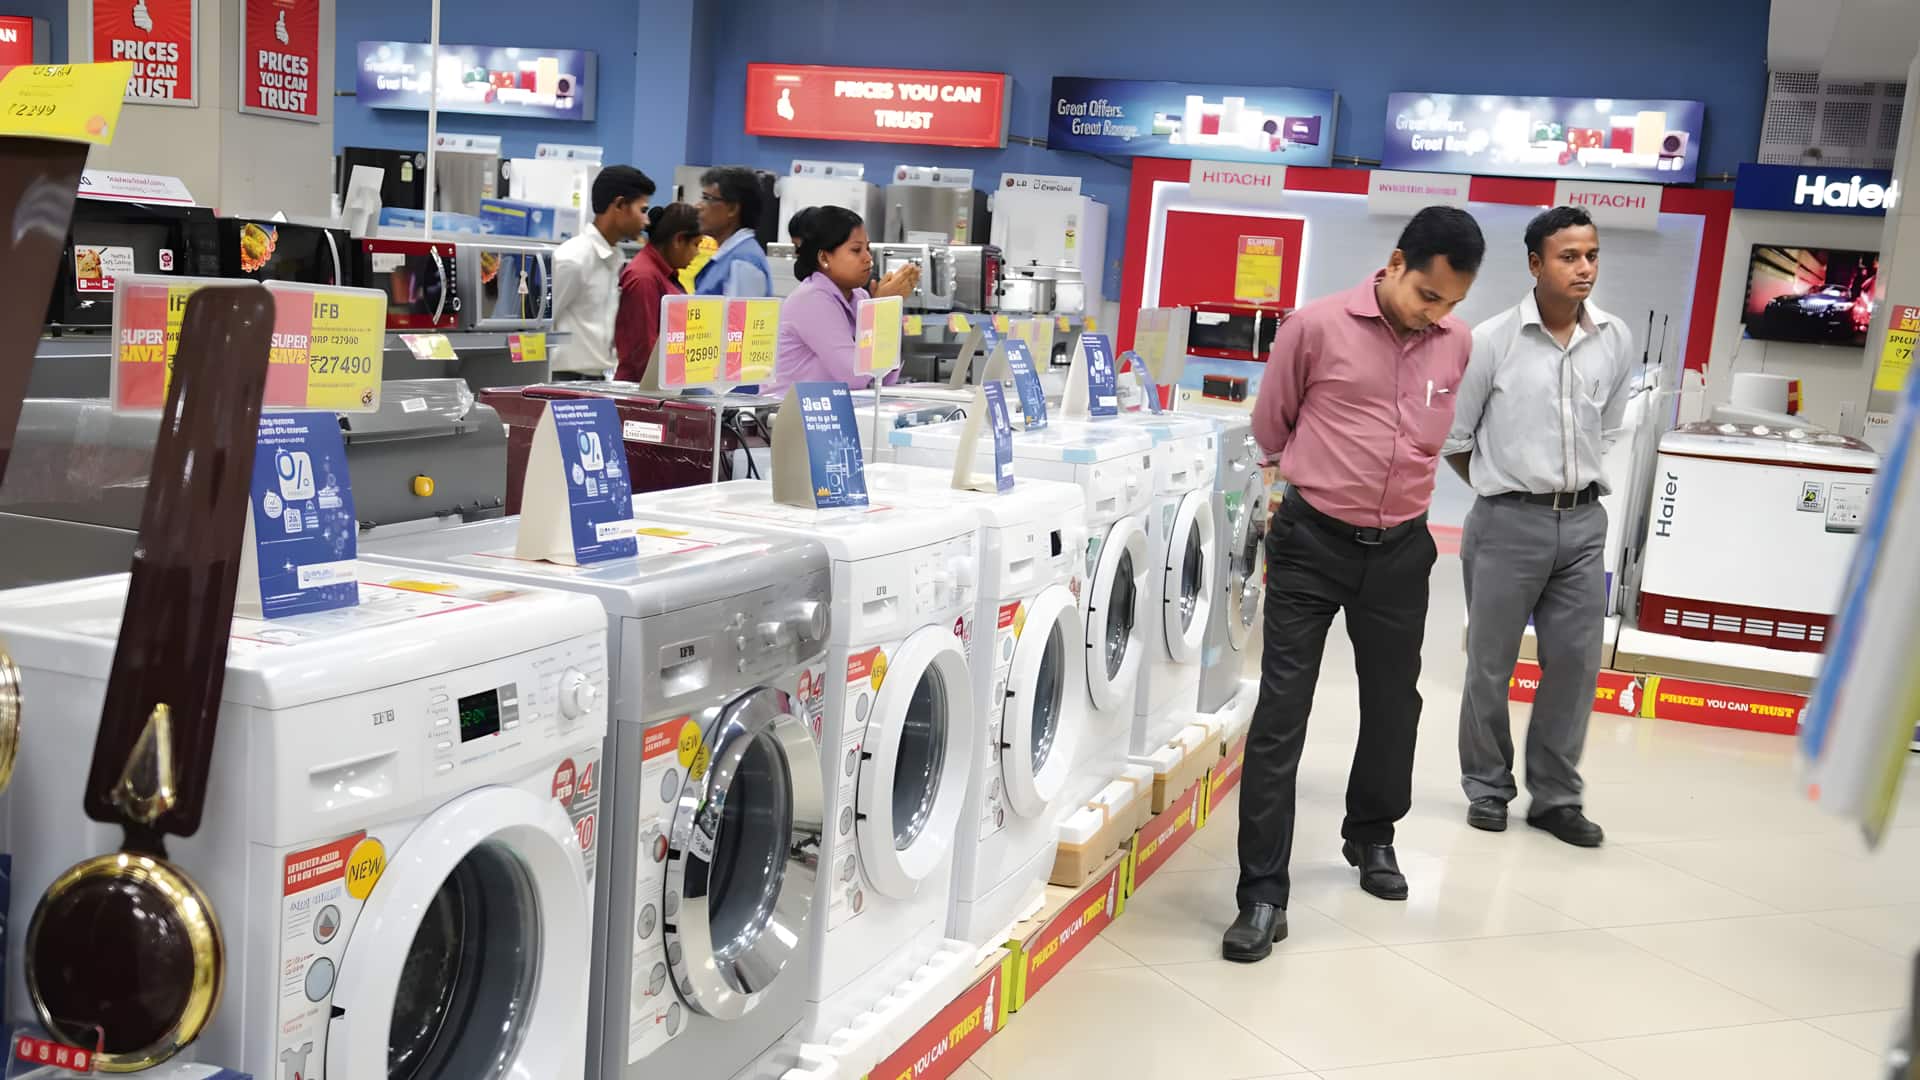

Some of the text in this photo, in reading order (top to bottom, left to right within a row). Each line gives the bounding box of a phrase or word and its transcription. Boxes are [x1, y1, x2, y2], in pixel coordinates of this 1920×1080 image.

[112, 39, 178, 63] PRICES
[150, 63, 178, 78] CAN
[259, 50, 309, 74] PRICES
[125, 79, 178, 99] RUST
[259, 71, 308, 91] YOU CAN
[258, 86, 308, 112] TRUST
[834, 80, 981, 103] PRICES YOU CAN
[1057, 98, 1087, 116] Great
[874, 110, 933, 129] TRUST
[1072, 117, 1101, 135] Great
[1412, 135, 1443, 151] Great
[1202, 171, 1271, 187] HITACHI
[1568, 192, 1647, 209] HITACHI
[1794, 174, 1900, 209] Haier
[169, 294, 188, 312] IF
[313, 302, 340, 320] IFB
[687, 308, 701, 321] IFB
[120, 328, 164, 345] SUPER
[271, 333, 309, 349] SUPER
[667, 331, 685, 343] SUPER
[120, 345, 164, 363] SAVE
[309, 355, 372, 376] ₹27490
[1655, 471, 1679, 537] Haier
[680, 645, 695, 658] IFB
[1659, 692, 1794, 719] PRICES YOU CAN TRUST
[372, 709, 394, 726] IFB
[680, 738, 699, 753] NEW
[577, 761, 593, 797] 4
[350, 856, 383, 882] NEW
[1032, 895, 1107, 973] PRICES YOU CAN TRUST
[913, 1051, 931, 1078] YOU
[931, 1036, 949, 1062] CAN
[948, 1005, 983, 1049] TRUST
[20, 1040, 87, 1068] USHA
